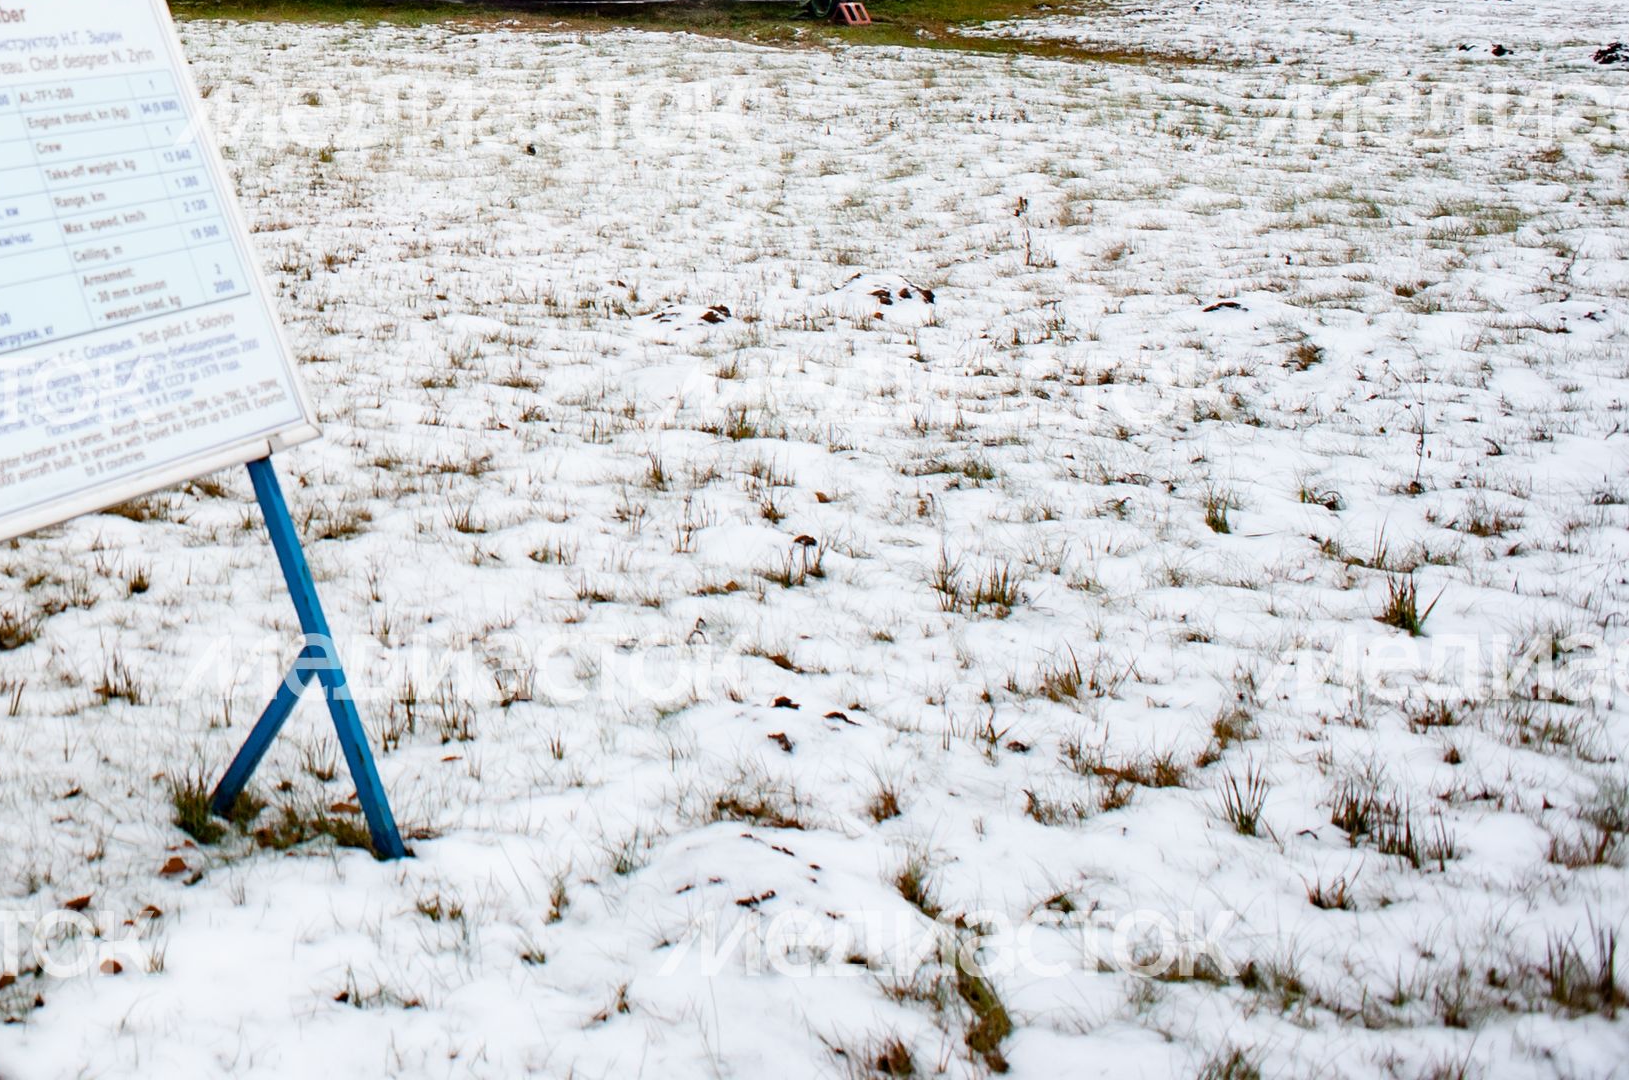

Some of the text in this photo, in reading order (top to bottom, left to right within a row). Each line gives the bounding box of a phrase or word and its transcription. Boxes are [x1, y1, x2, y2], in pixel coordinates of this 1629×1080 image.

[28, 53, 60, 72] Chief
[61, 53, 109, 70] designer
[125, 47, 155, 64] Zyrin
